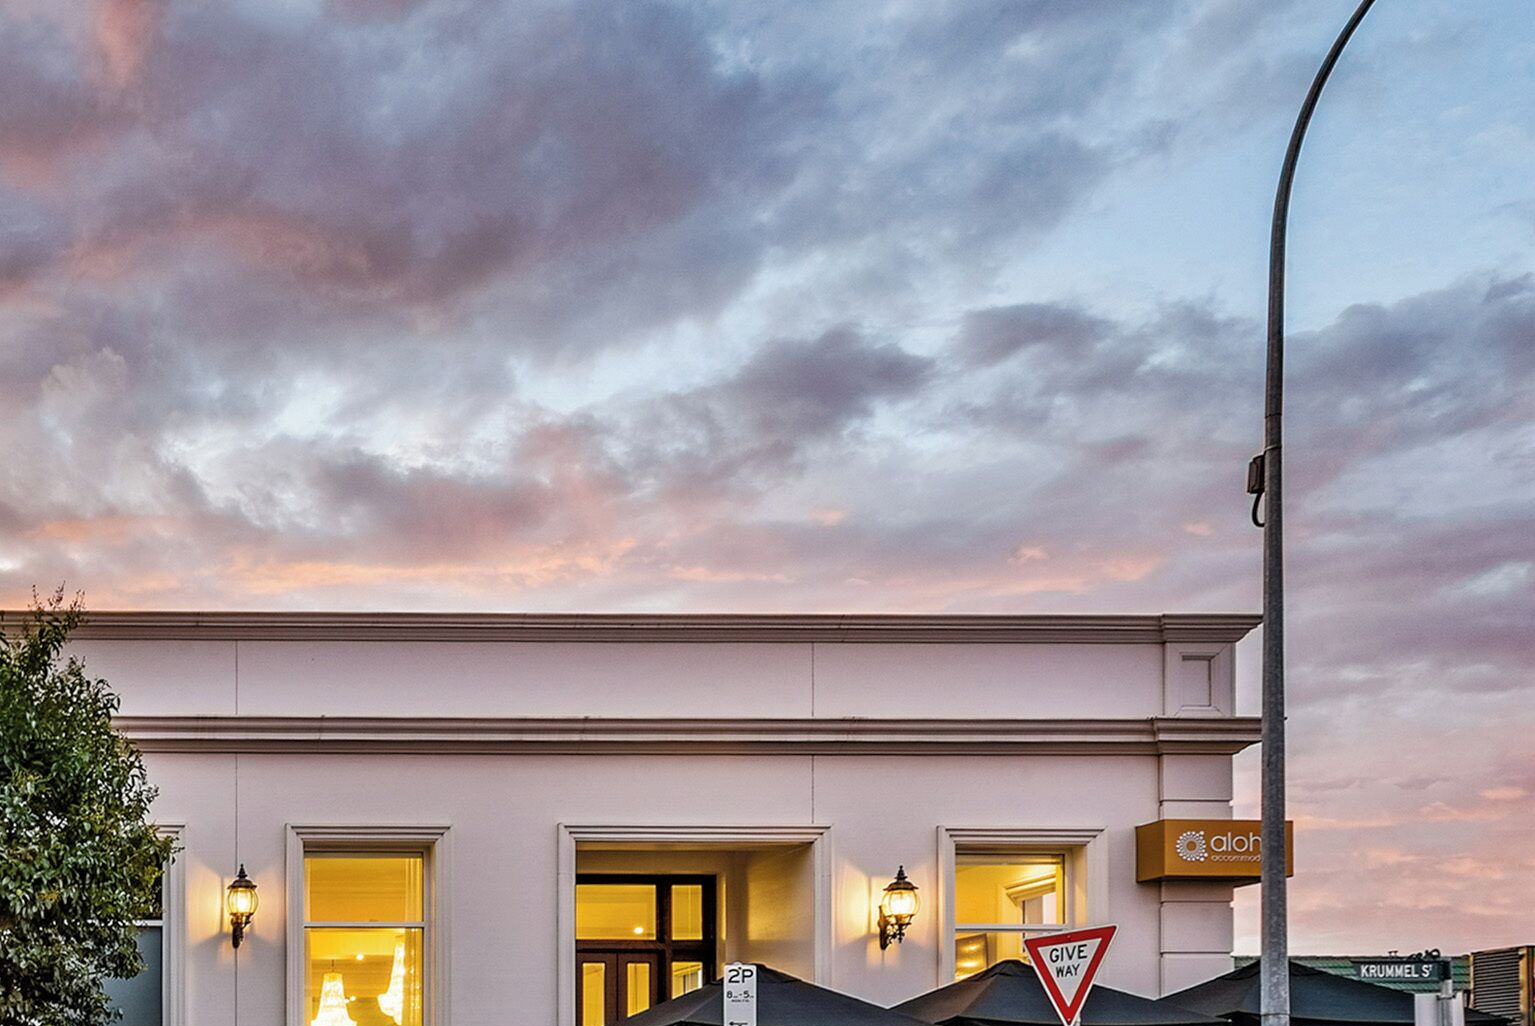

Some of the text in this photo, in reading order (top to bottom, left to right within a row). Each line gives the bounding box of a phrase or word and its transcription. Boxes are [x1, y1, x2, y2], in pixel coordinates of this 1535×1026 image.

[1210, 832, 1261, 852] aloh
[1049, 944, 1088, 963] GIVE
[728, 968, 753, 983] 2P
[1055, 963, 1081, 978] WAY
[1360, 965, 1419, 978] KRUMMEL
